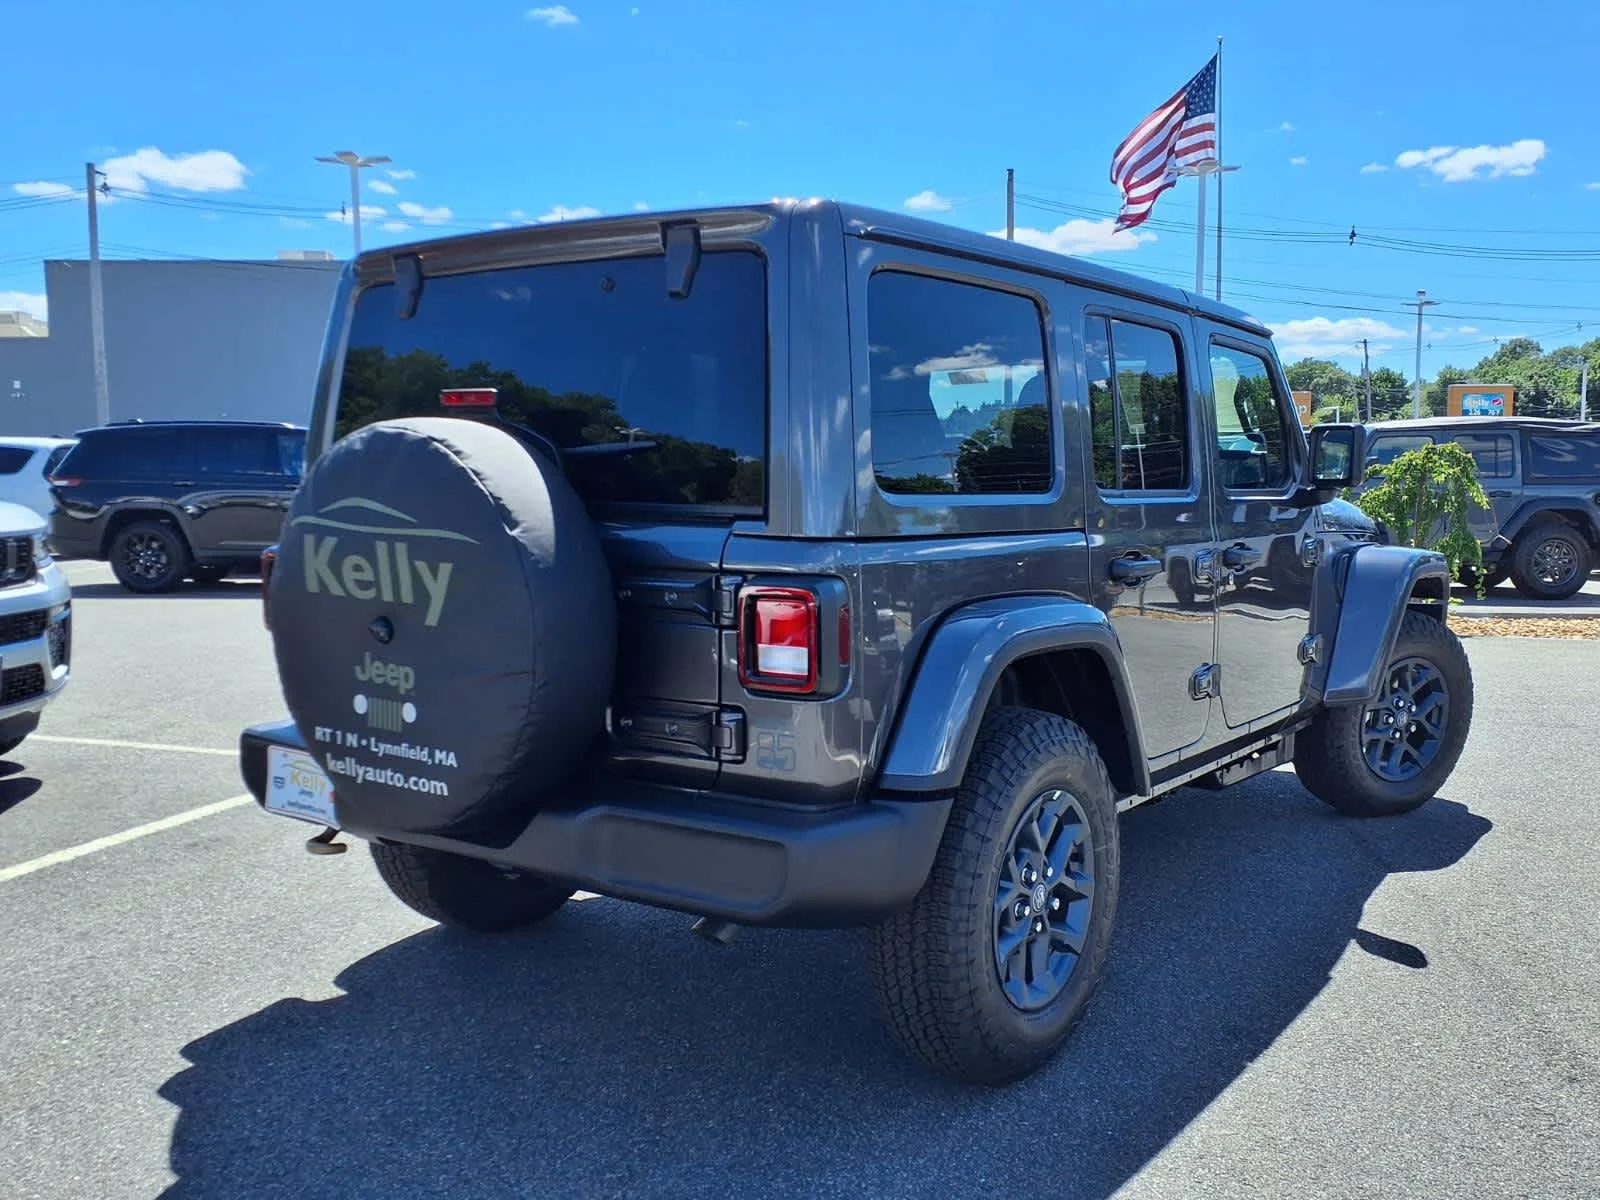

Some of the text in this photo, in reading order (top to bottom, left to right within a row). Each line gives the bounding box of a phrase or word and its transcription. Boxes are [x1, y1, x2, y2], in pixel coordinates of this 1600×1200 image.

[303, 533, 454, 627] Kelly
[353, 651, 416, 695] Jeep
[314, 726, 458, 768] RT 1 N Lynnfield, MA
[325, 753, 449, 797] kellyauto.com
